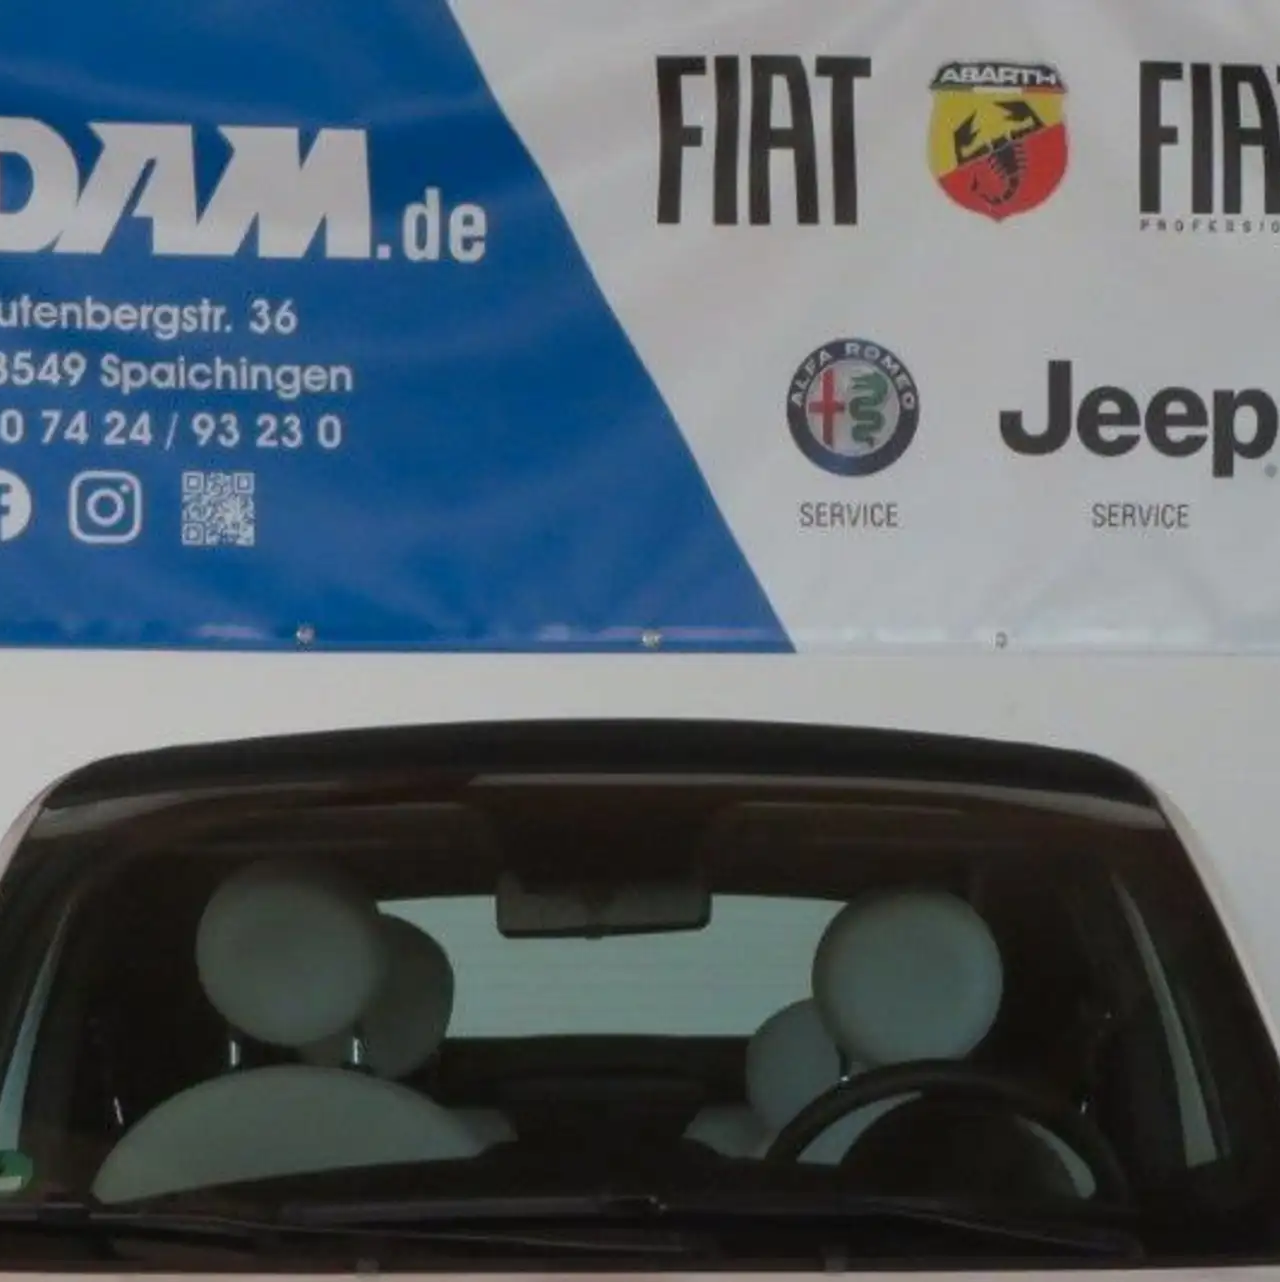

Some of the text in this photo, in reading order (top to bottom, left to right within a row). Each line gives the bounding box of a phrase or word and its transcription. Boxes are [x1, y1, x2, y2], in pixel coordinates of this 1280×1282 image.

[940, 65, 1057, 85] ABARTH
[656, 55, 872, 226] FIAT
[249, 298, 298, 335] 36
[100, 352, 354, 399] Spaichingen
[790, 342, 916, 411] ALFA ROMEO
[40, 409, 89, 446] 74
[104, 410, 152, 446] 24
[162, 412, 179, 451] /
[191, 412, 241, 448] 93
[255, 413, 302, 449] 23
[318, 414, 342, 450] 0
[999, 359, 1279, 479] Jeep
[799, 502, 899, 528] SERVICE
[1091, 503, 1190, 529] SERVICE
